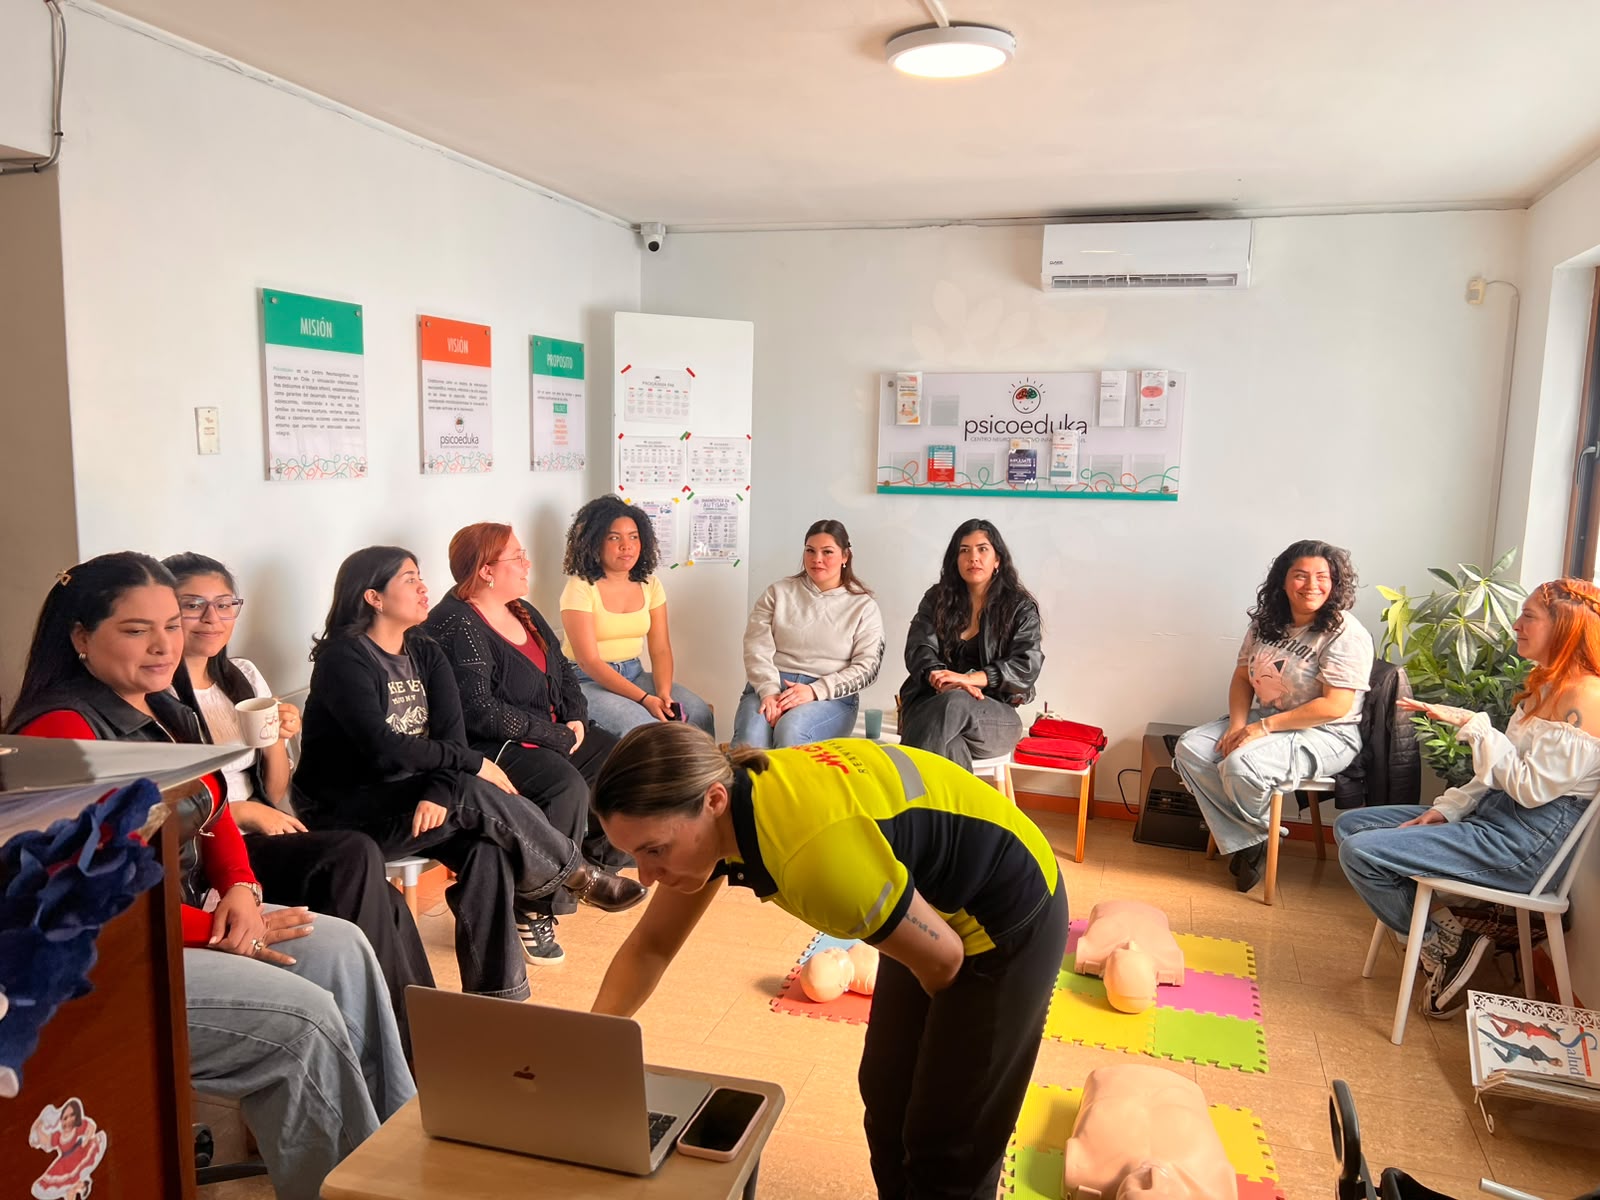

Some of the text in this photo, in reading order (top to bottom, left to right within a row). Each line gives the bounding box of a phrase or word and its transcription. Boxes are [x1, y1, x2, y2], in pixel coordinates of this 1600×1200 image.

[300, 316, 333, 338] MISIÓN
[447, 336, 469, 354] VISIÓN
[964, 413, 1088, 442] psicoeduka
[440, 432, 479, 449] psicoeduka
[1555, 1026, 1599, 1078] Salud
